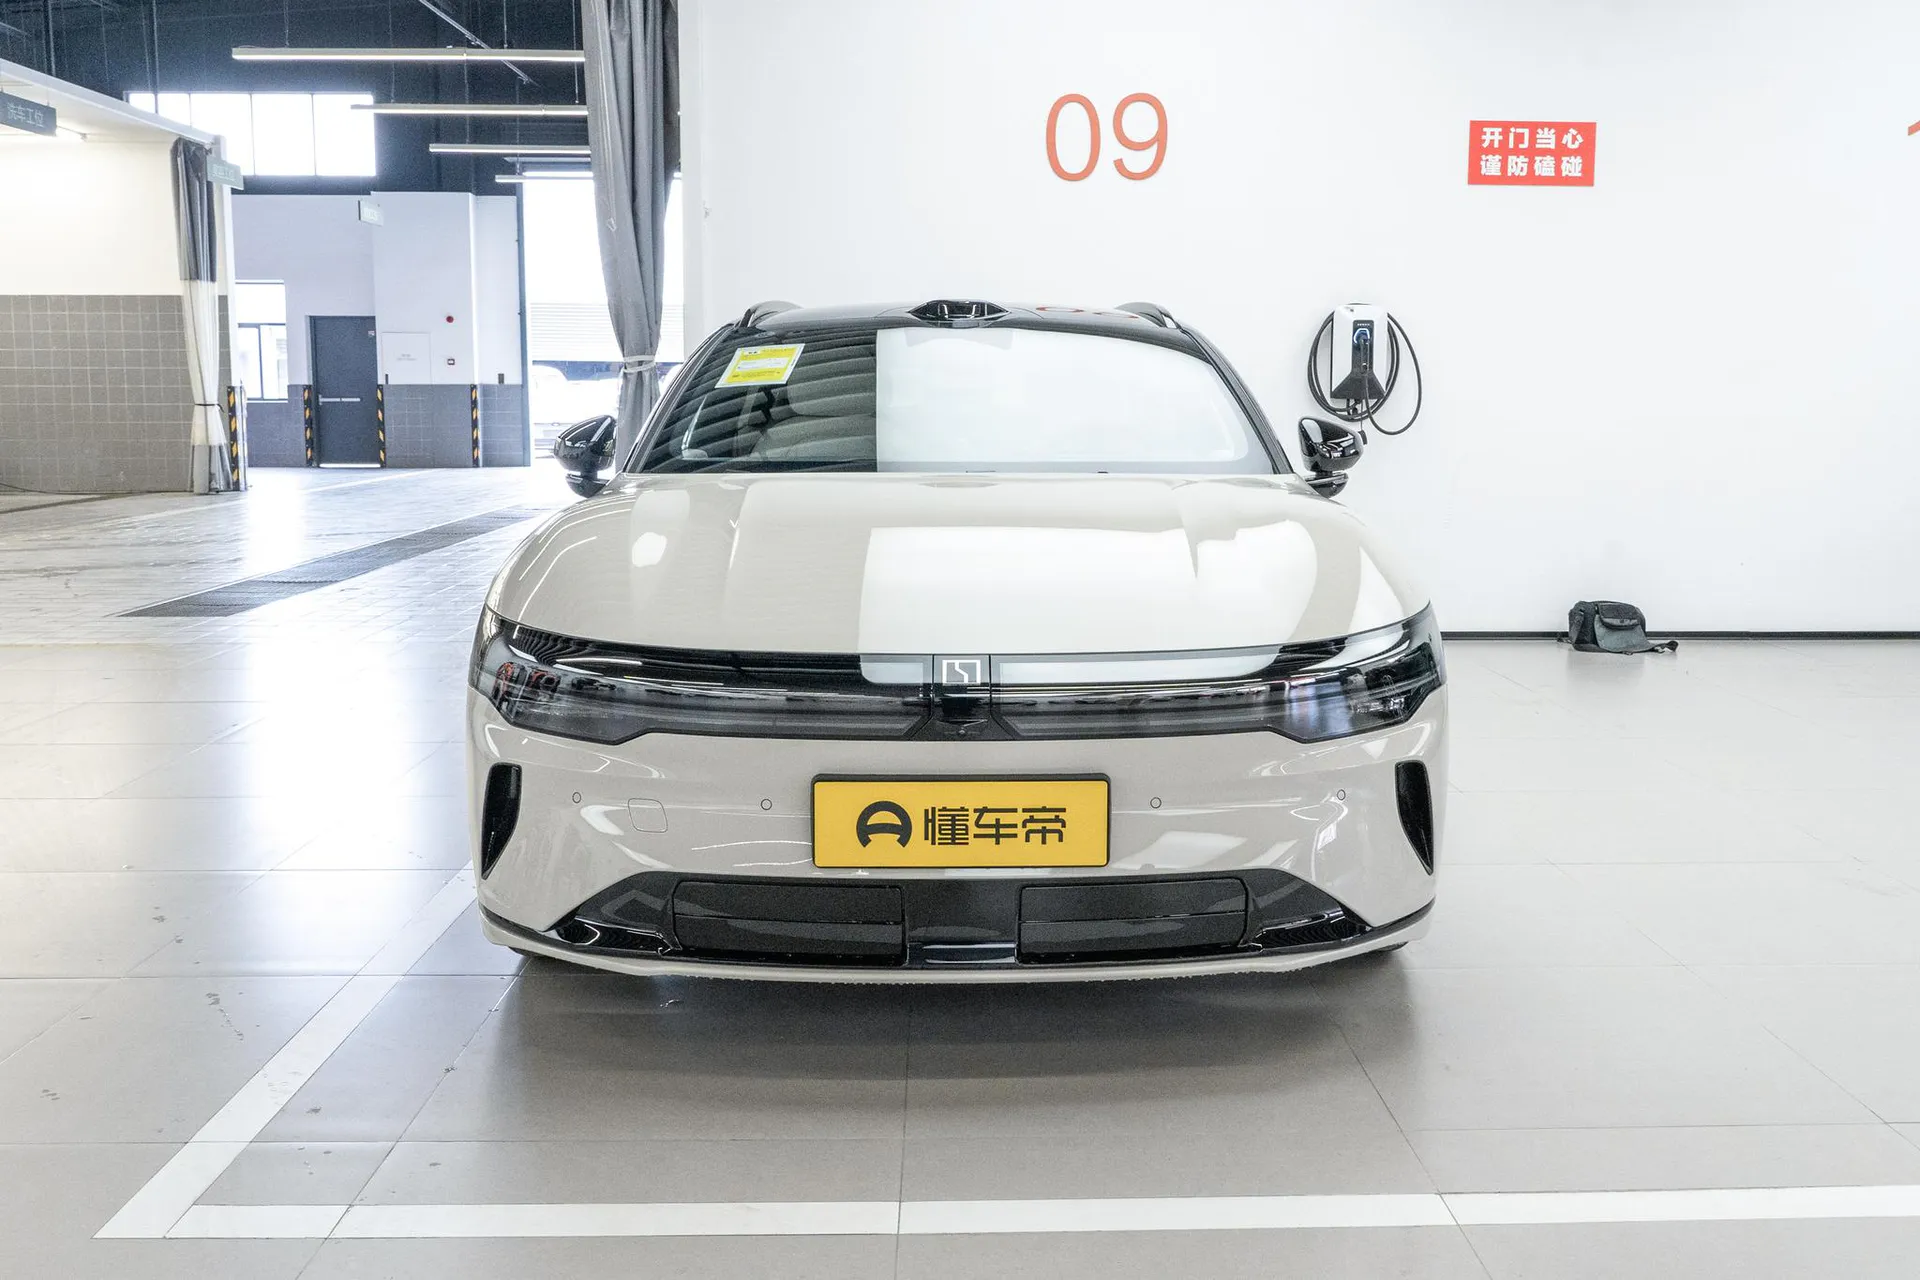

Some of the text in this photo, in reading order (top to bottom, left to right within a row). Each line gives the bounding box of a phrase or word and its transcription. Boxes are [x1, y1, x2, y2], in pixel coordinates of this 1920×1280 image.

[7, 102, 45, 128] 洗车工位
[1046, 92, 1168, 182] 09
[1481, 127, 1584, 149] 开门当心
[1480, 154, 1583, 177] 谨防磕碰
[924, 806, 1067, 846] 懂车帝
